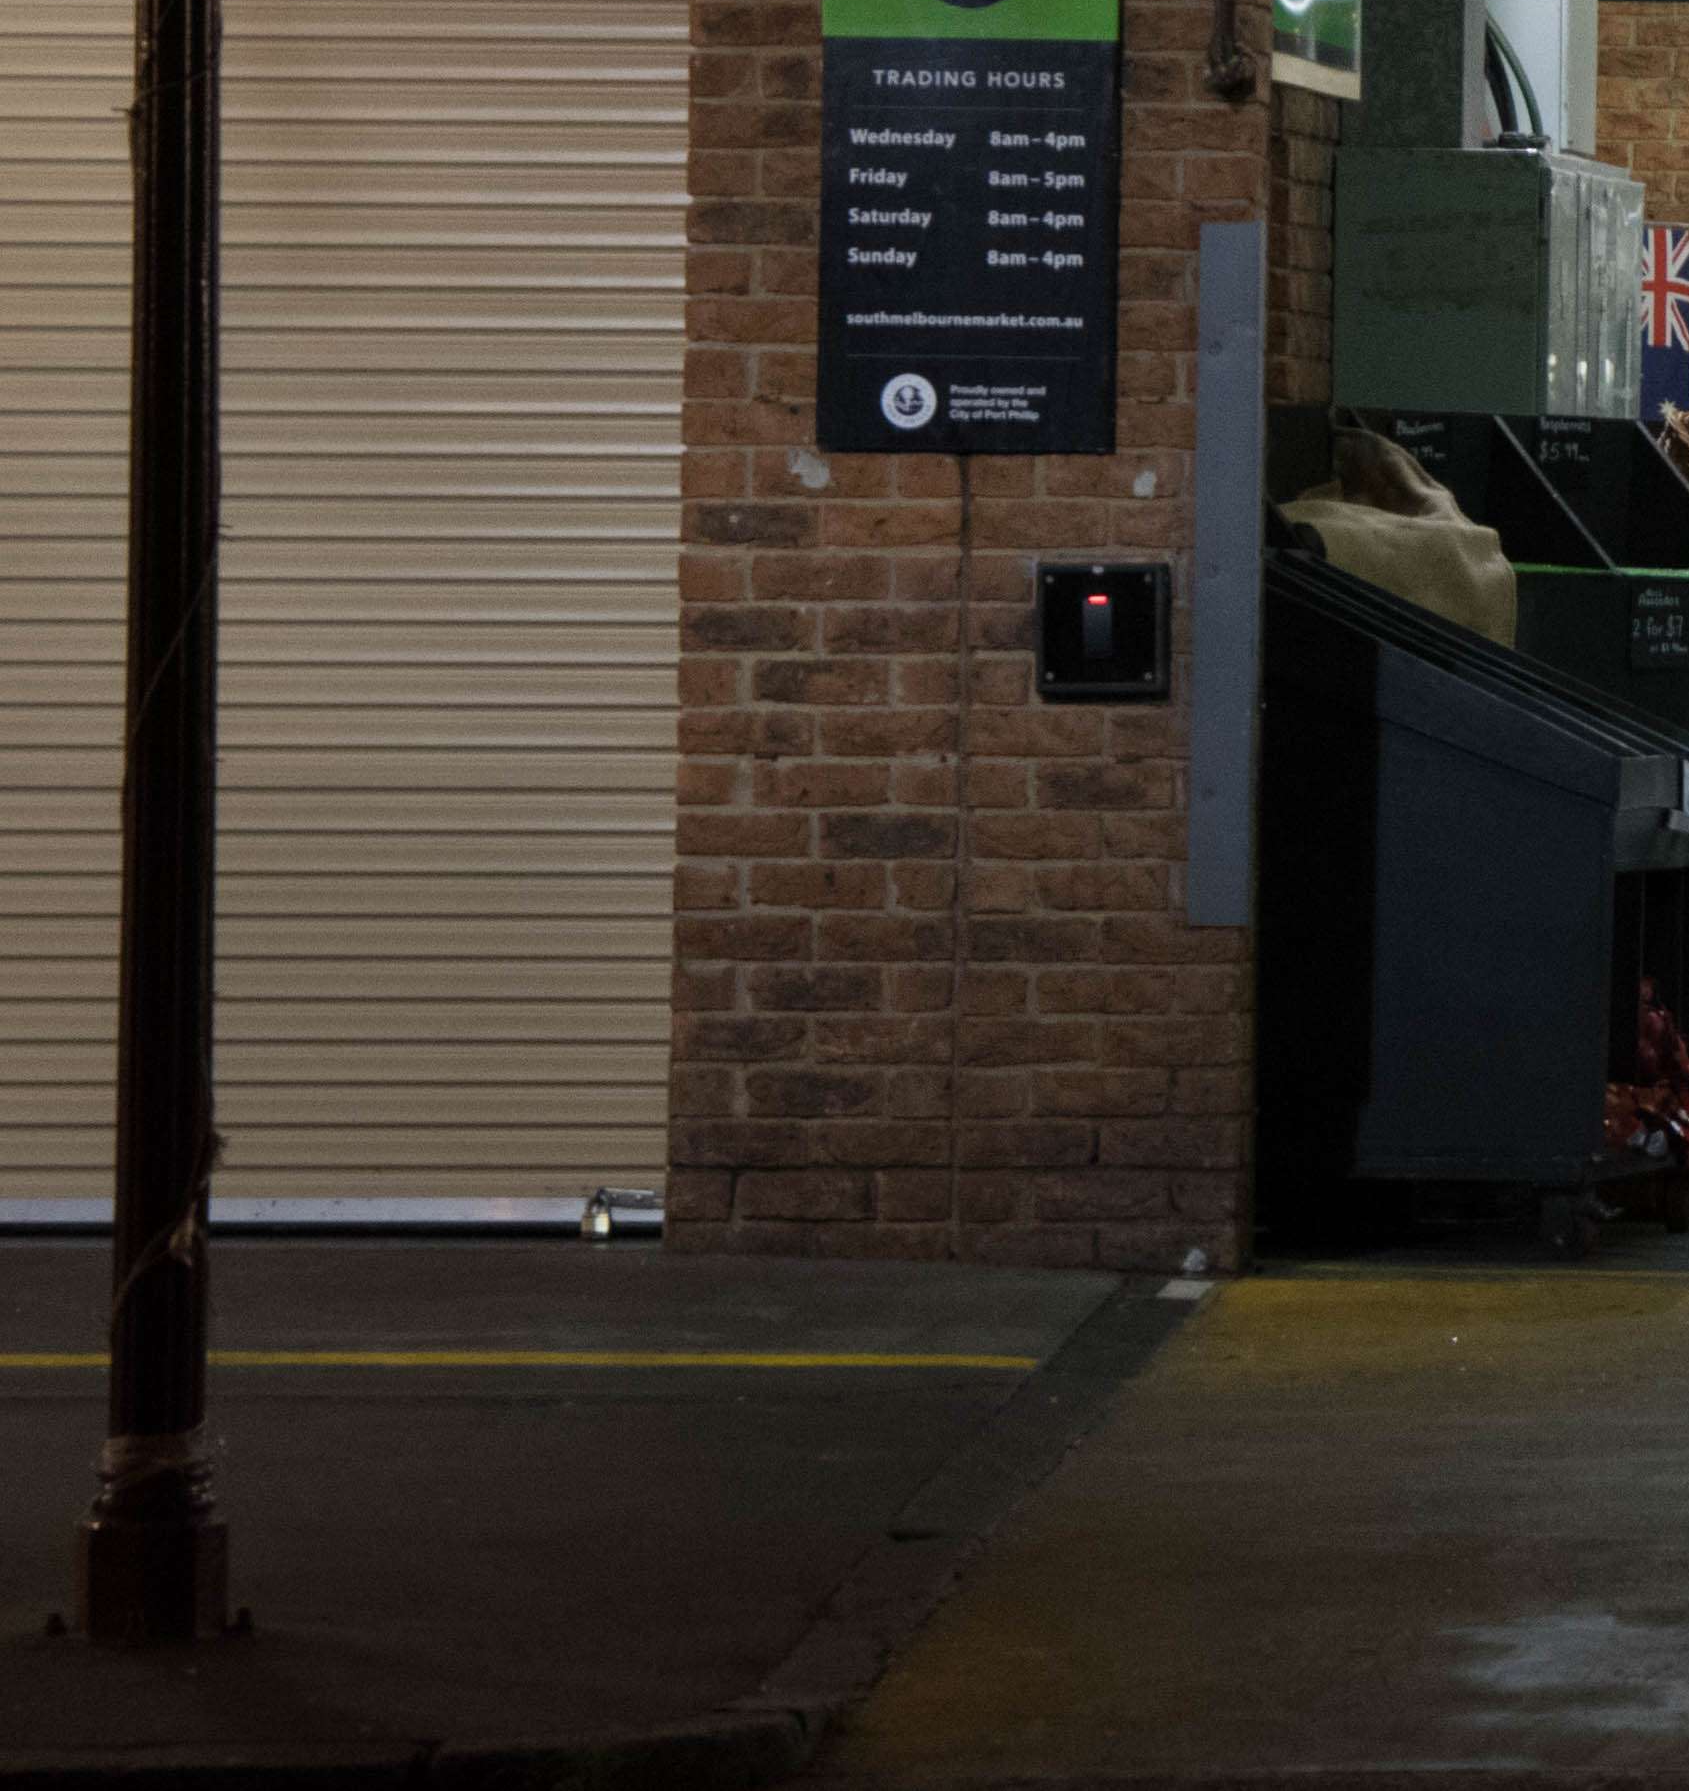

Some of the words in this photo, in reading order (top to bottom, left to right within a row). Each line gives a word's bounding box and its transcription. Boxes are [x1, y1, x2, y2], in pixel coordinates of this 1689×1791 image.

[872, 69, 977, 87] TRADING
[986, 70, 1066, 89] HOURS
[849, 128, 956, 150] Wednesday
[848, 167, 908, 189] Friday
[847, 207, 933, 229] Saturday
[847, 246, 918, 269] Sunday
[846, 311, 1084, 328] southmelbournemarket.com.au
[949, 384, 989, 397] Proudly
[990, 385, 1025, 396] owned
[1026, 385, 1047, 396] and
